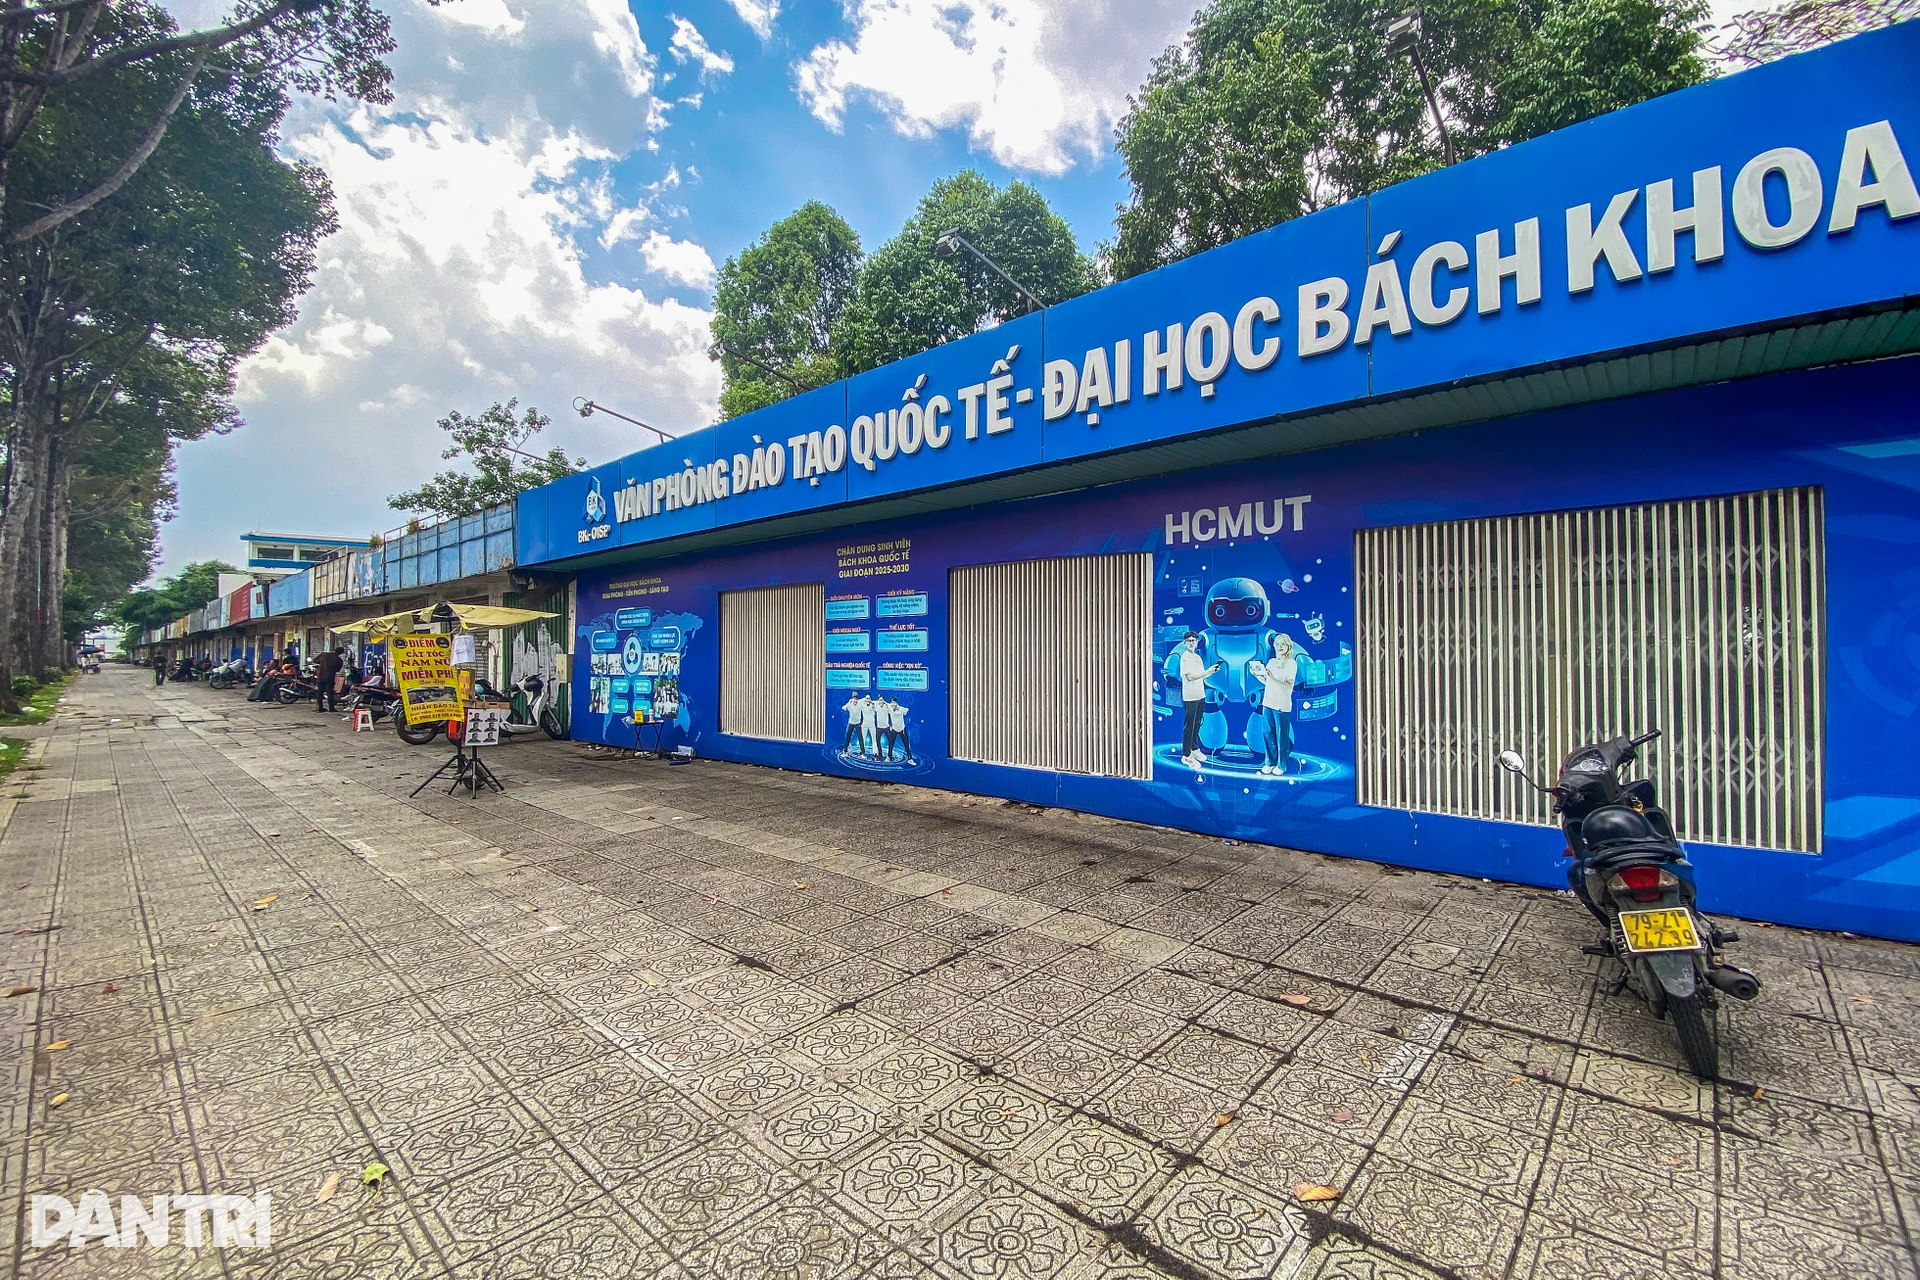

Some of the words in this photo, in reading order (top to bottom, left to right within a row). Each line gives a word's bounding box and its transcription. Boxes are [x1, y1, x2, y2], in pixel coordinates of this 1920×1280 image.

[613, 477, 652, 523] VĂN
[652, 460, 729, 514] PHÒNG
[732, 434, 786, 492] ĐÀO
[788, 424, 847, 486] TẠO
[850, 374, 952, 471] QUỐC
[1041, 338, 1131, 426] ĐẠI
[1143, 296, 1281, 398] HỌC
[1298, 218, 1542, 357] BÁCH
[1566, 119, 1920, 294] KHOA
[1165, 495, 1312, 545] HCMUT
[836, 547, 855, 556] CHÂN
[856, 543, 876, 554] DUNG
[877, 541, 893, 551] SINH
[895, 538, 911, 549] VIÊN
[838, 557, 857, 567] BÁCH
[858, 555, 877, 565] KHOA
[879, 550, 900, 563] QUỐC
[901, 548, 911, 560] TẾ
[838, 569, 853, 578] GIAI
[853, 567, 874, 578] ĐOẠN
[874, 564, 910, 575] 2025-2030
[400, 658, 431, 667] NAM
[402, 667, 434, 680] MIỄN
[436, 668, 454, 679] PHÍ
[1630, 910, 1682, 931] 79-Z1
